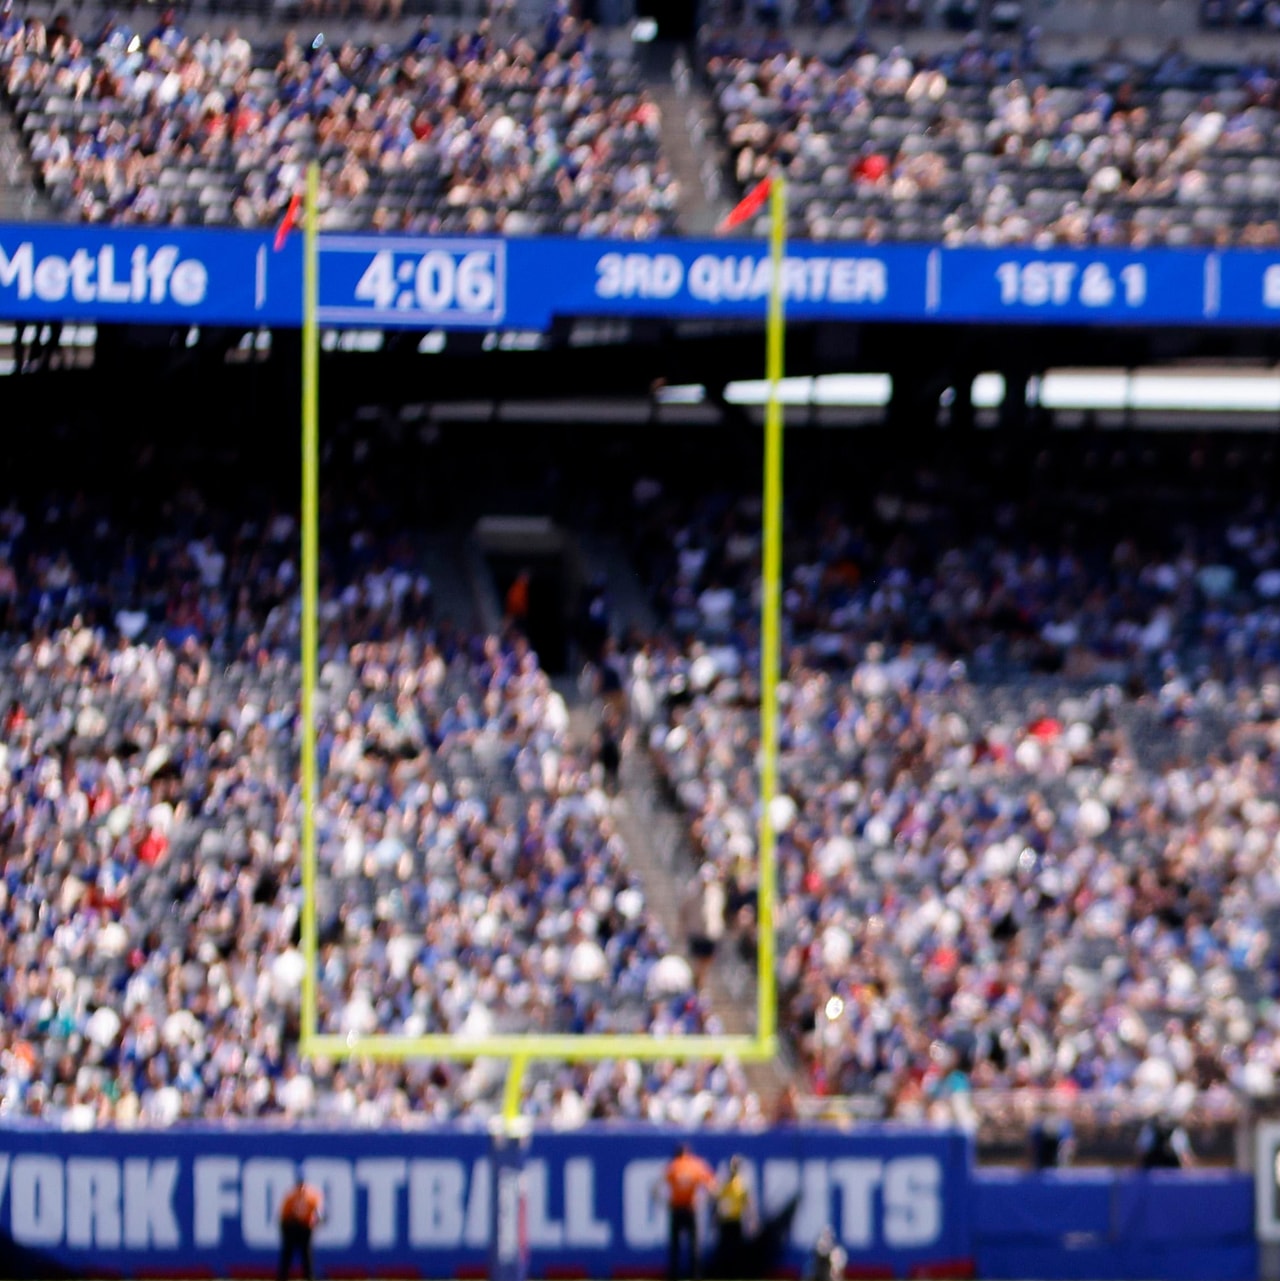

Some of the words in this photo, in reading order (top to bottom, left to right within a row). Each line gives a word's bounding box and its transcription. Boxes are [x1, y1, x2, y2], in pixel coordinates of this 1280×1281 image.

[354, 249, 495, 313] 4:06
[595, 252, 684, 299] 3RD
[687, 255, 887, 303] QUARTER
[995, 261, 1075, 306] 1ST
[1079, 261, 1114, 307] &
[1120, 263, 1147, 307] 1
[0, 1154, 180, 1250] ORK
[623, 1156, 941, 1250] GNTS
